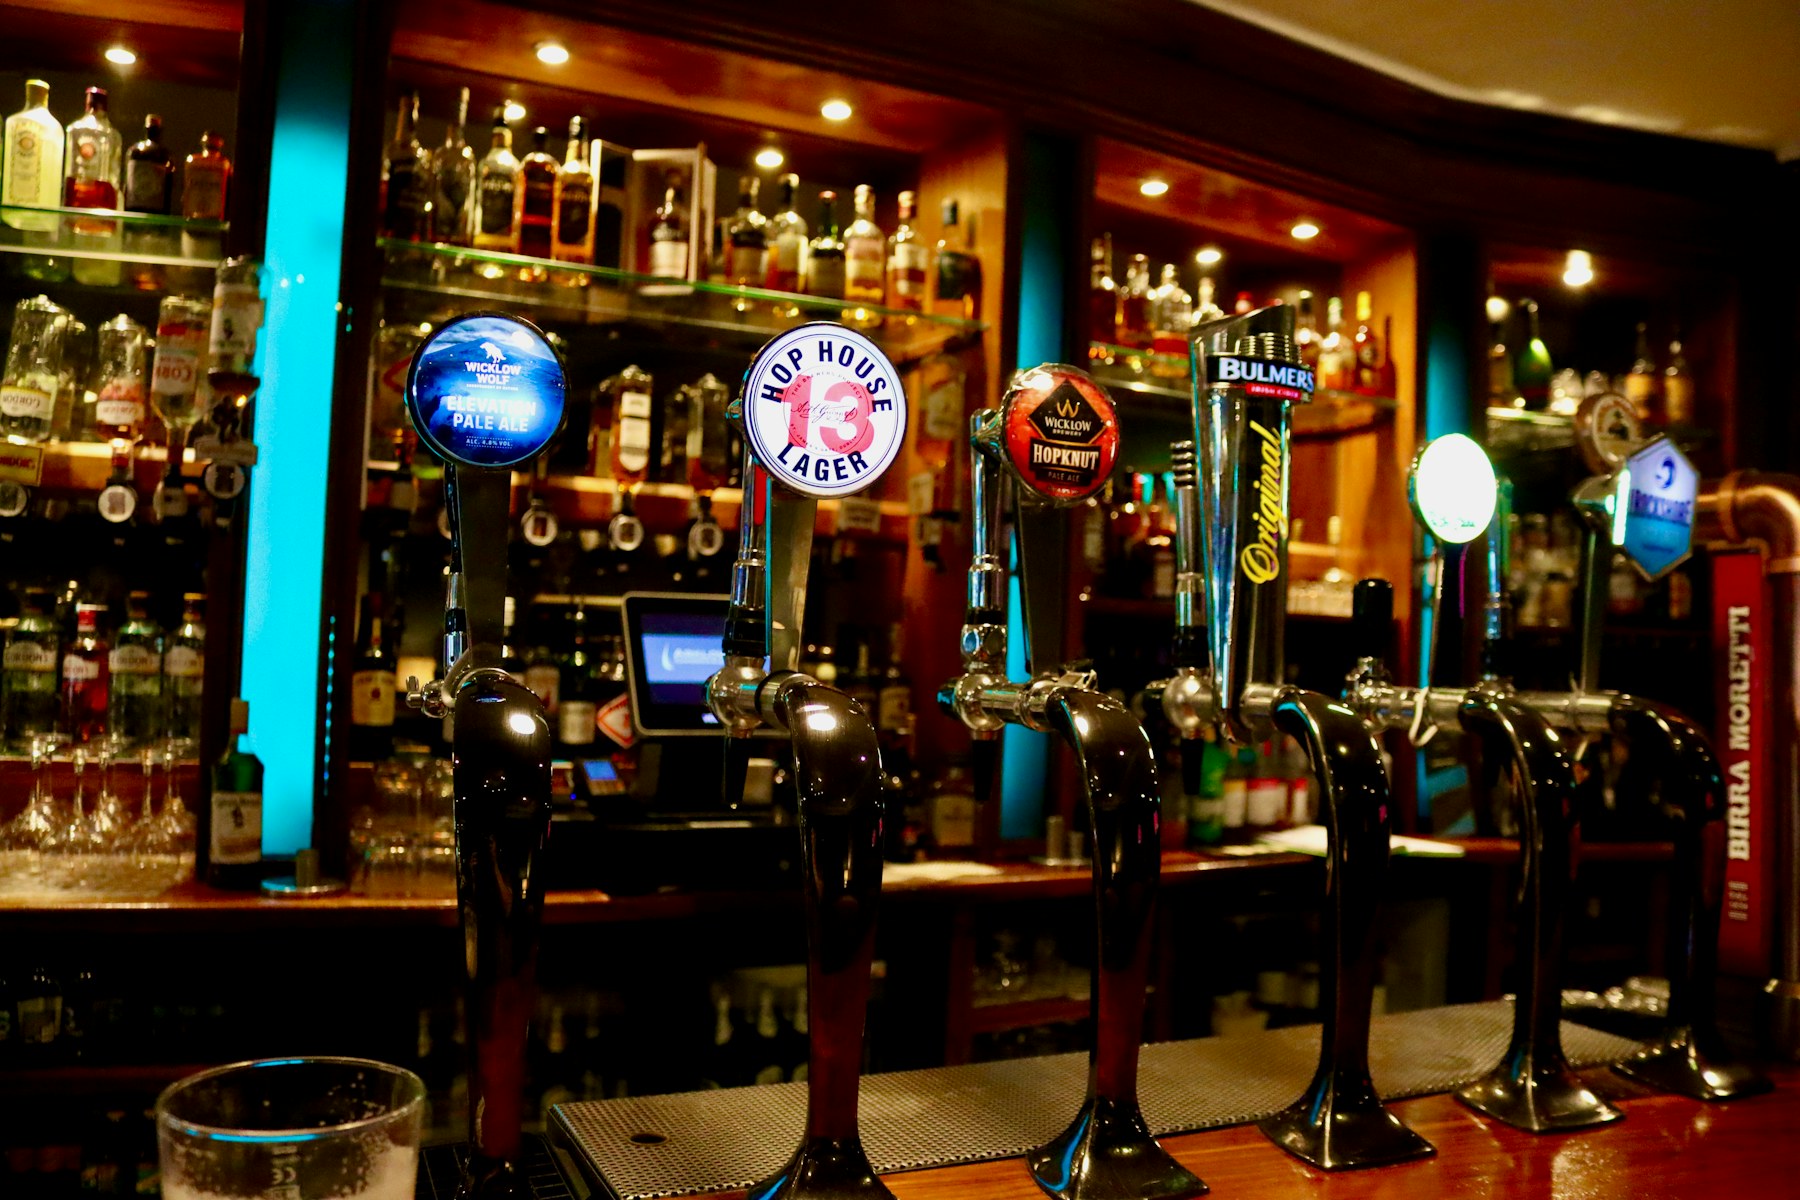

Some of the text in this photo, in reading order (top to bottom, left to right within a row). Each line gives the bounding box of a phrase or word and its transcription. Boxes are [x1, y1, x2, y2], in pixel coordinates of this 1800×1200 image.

[465, 362, 521, 375] WICKLOW
[476, 374, 510, 385] WOLF
[761, 341, 893, 413] HOP HOUSE
[1219, 357, 1314, 392] BULMERS
[1251, 386, 1275, 394] IRISH
[447, 395, 537, 416] ELEVATION
[780, 374, 875, 454] 13
[453, 413, 529, 432] PALE ALE
[1044, 416, 1092, 432] WICKLOW
[1052, 428, 1083, 437] BREWERY
[777, 442, 869, 481] LAGER
[1033, 444, 1099, 470] HOPKNUT
[1048, 471, 1081, 483] PALE ALE
[1240, 420, 1290, 584] Original
[1728, 606, 1751, 751] MORETTI
[1728, 760, 1750, 861] BIRRA
